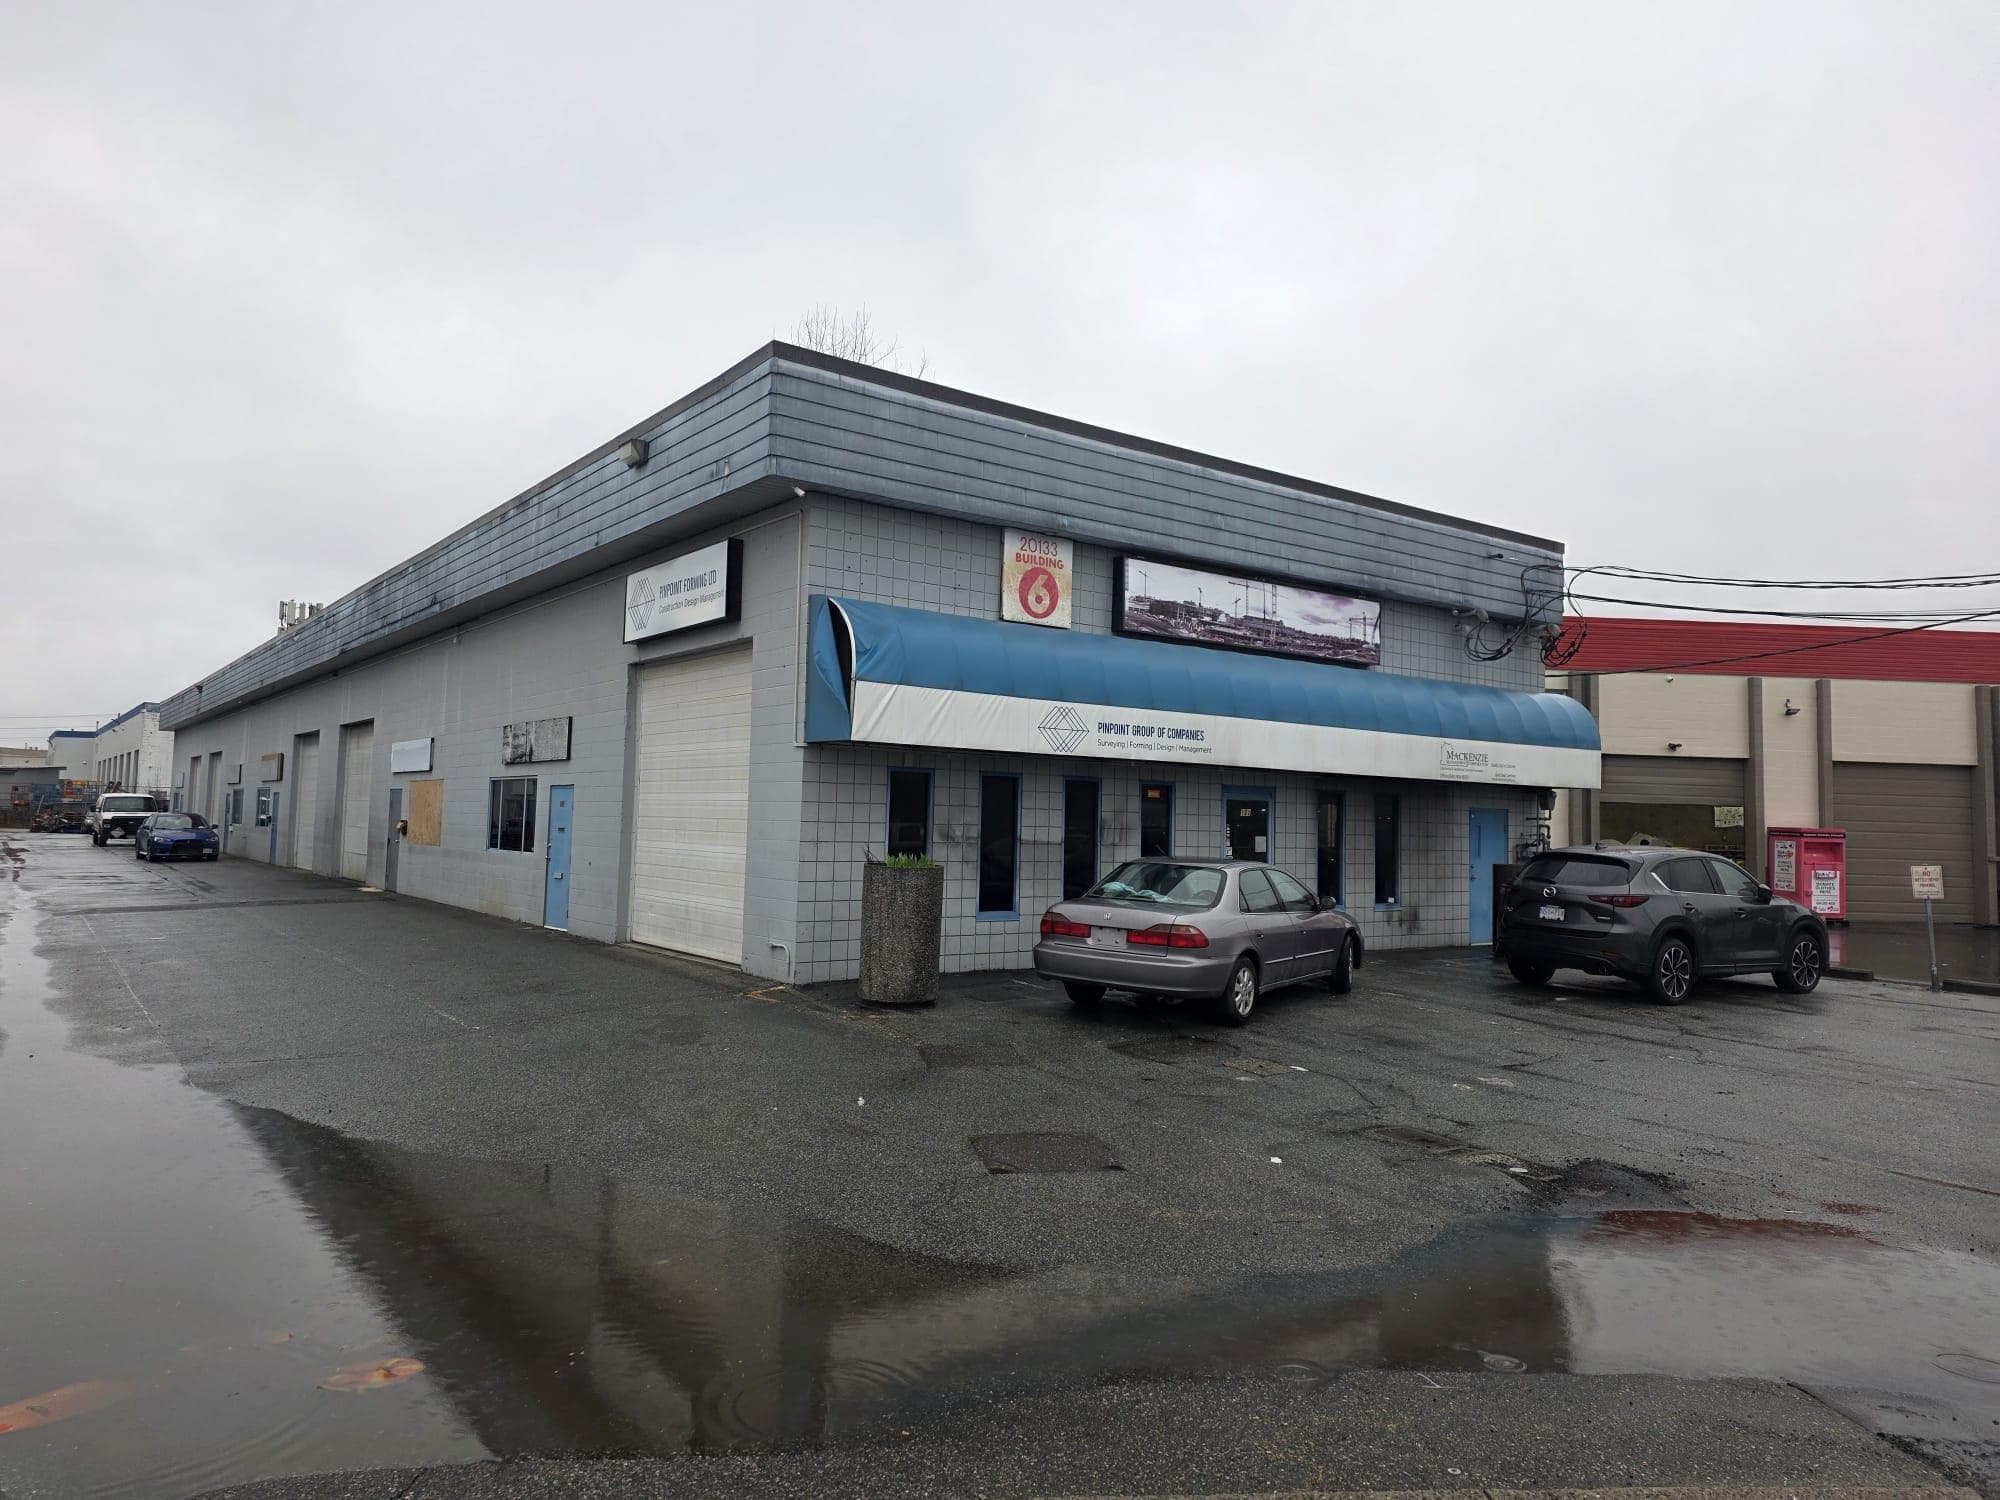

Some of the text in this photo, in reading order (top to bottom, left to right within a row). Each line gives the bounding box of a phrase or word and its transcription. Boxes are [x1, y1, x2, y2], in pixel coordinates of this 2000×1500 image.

[1020, 537, 1058, 557] 20133
[1015, 552, 1064, 569] BUILDING
[659, 570, 717, 599] PINPOINT FORMING LTD
[1028, 574, 1050, 613] 6
[1097, 722, 1205, 741] PINPOINT GROUP OF COMPANIES
[1097, 738, 1212, 754] Surveying Forming Design Management
